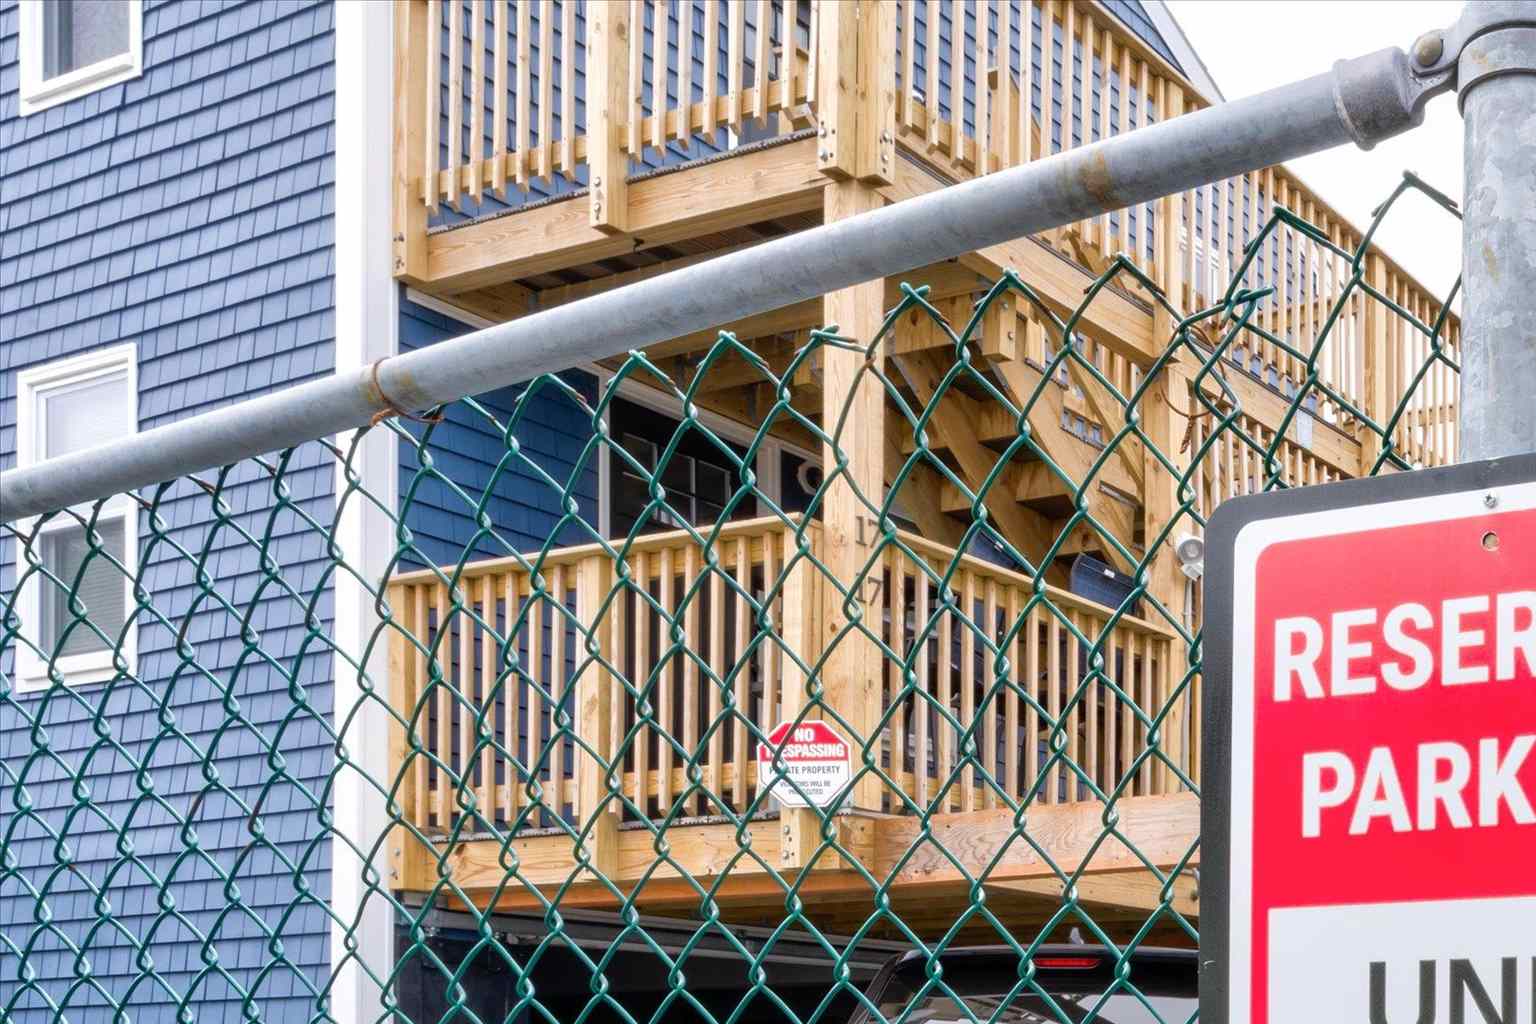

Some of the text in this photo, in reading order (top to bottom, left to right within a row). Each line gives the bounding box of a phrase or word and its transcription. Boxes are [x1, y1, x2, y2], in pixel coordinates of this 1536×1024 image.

[794, 728, 815, 742] NO
[764, 743, 844, 758] TESPASSING
[801, 765, 840, 775] PROPERTY
